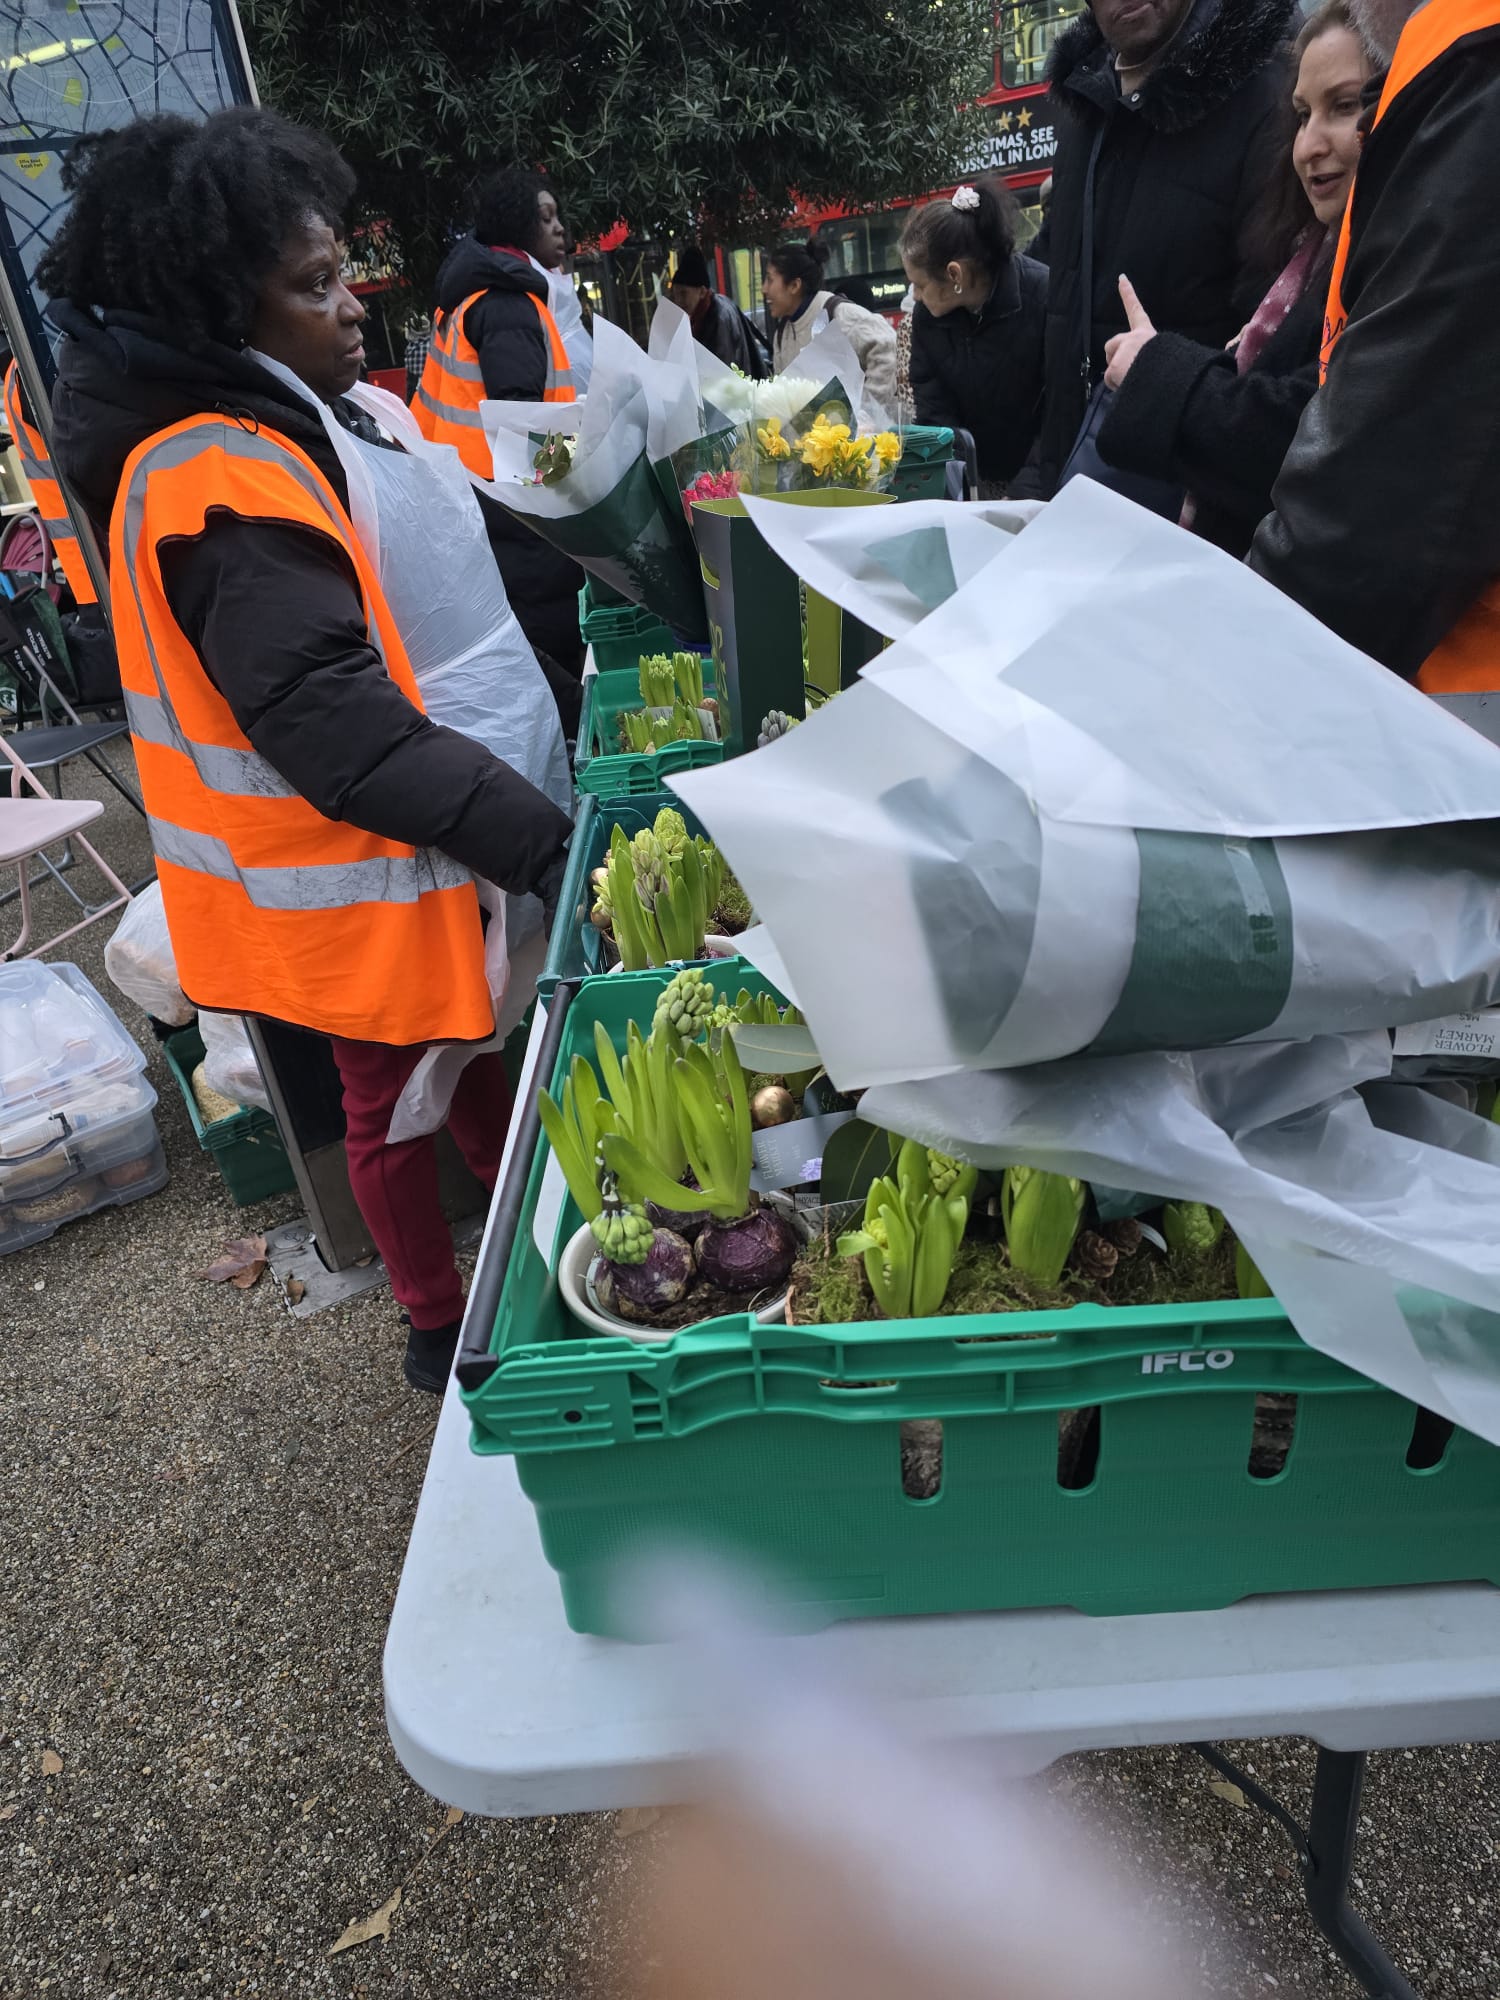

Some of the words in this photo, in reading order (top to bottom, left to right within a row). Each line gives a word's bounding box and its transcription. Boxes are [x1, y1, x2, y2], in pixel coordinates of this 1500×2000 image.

[1030, 126, 1054, 143] SEE
[957, 153, 1006, 174] USICAL
[1008, 148, 1023, 165] IN
[1434, 1028, 1495, 1045] MARKET
[1434, 1039, 1492, 1054] FLOWER
[1141, 1349, 1235, 1375] IFCO
